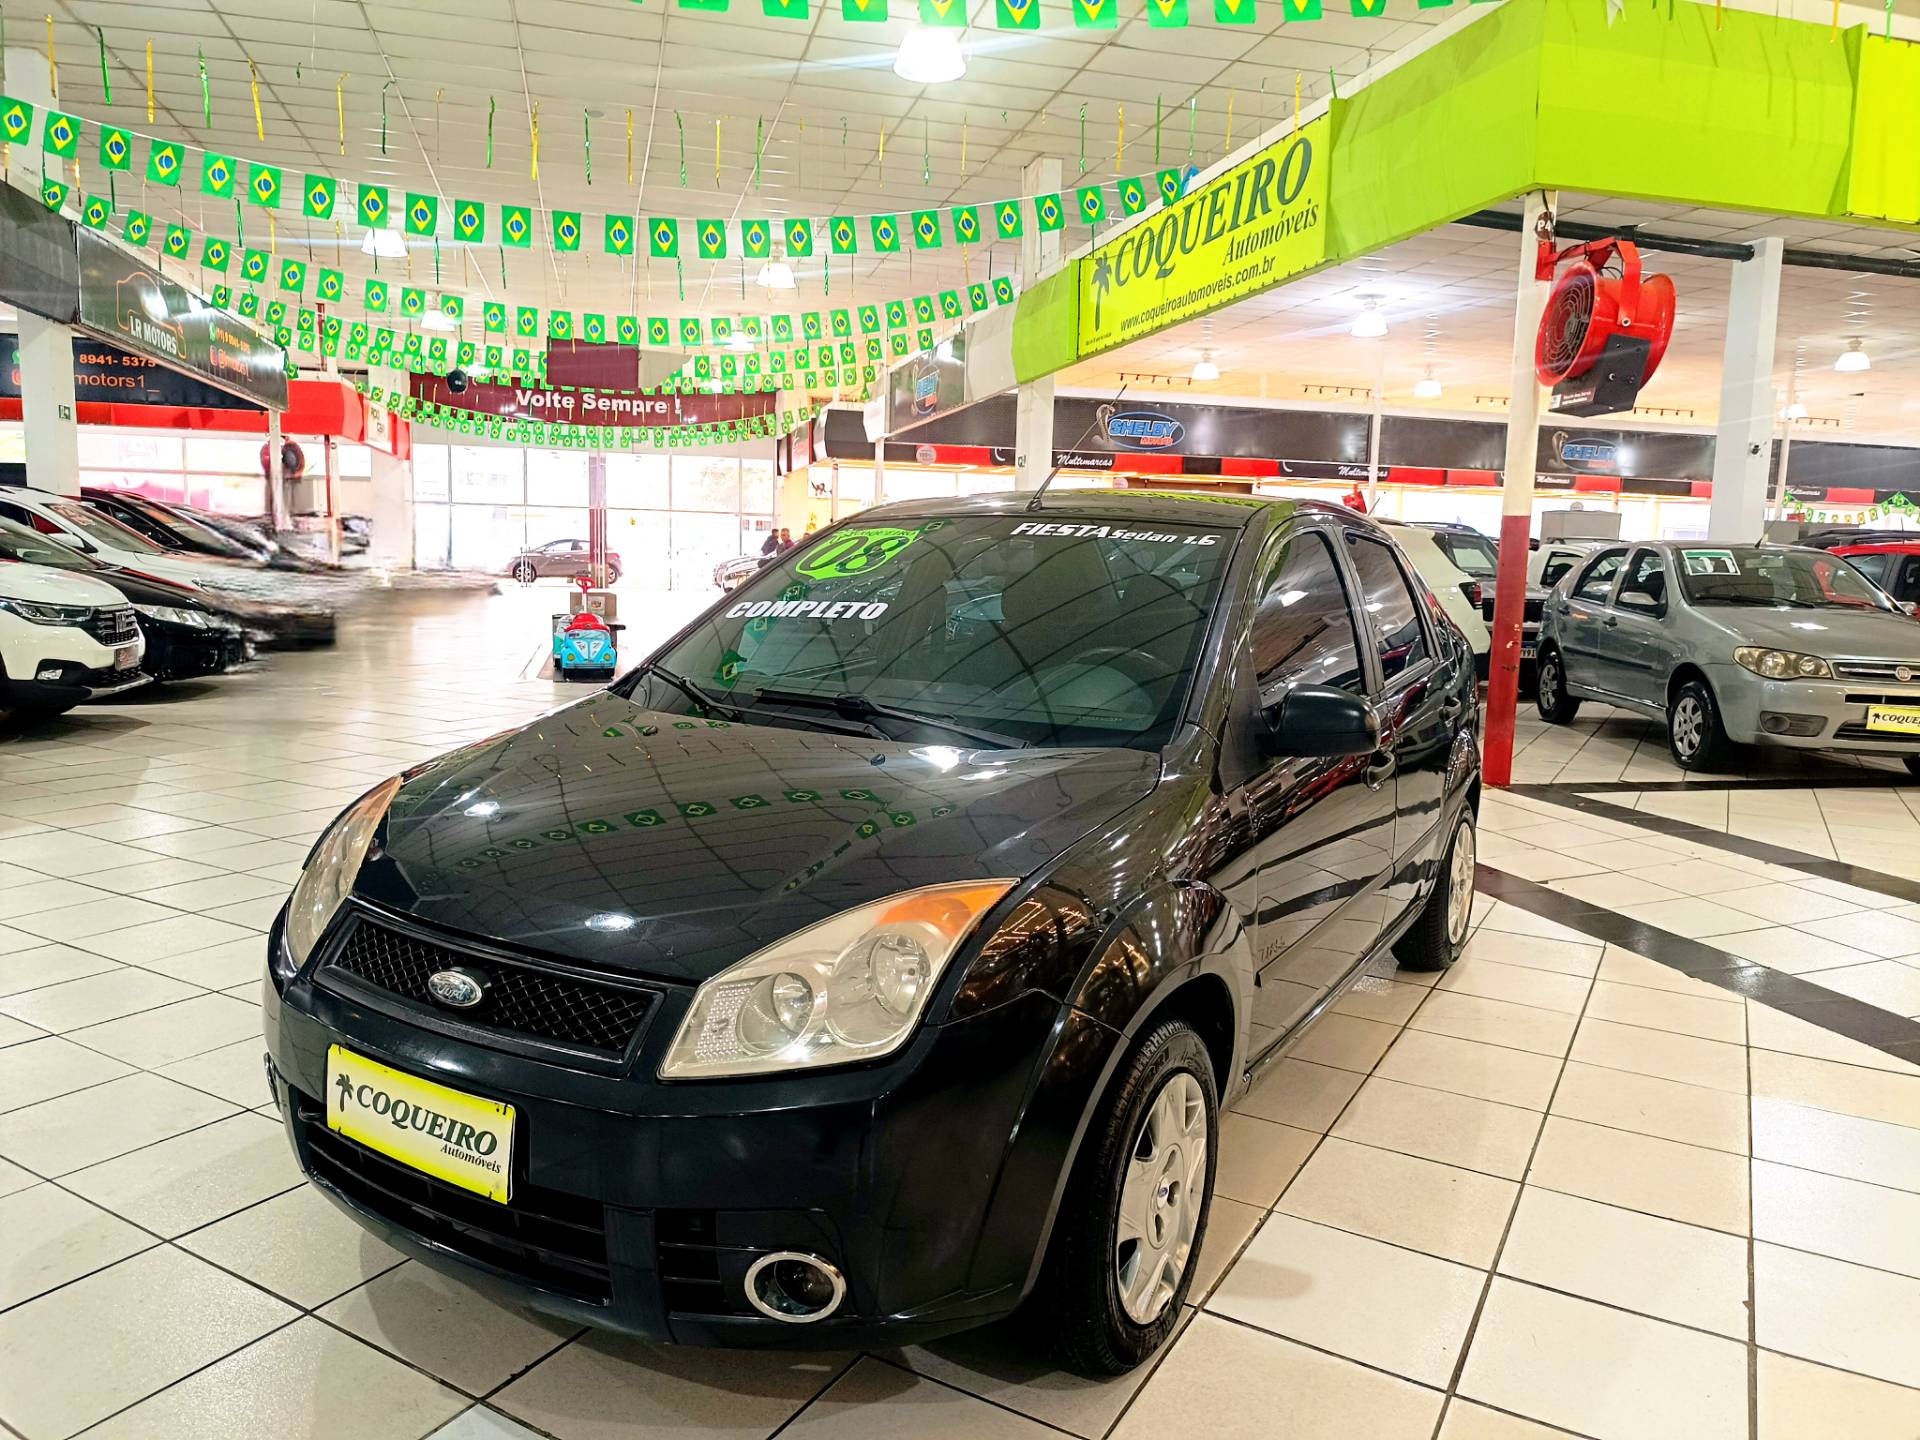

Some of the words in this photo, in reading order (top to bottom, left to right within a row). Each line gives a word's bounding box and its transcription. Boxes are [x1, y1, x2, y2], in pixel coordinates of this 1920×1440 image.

[1115, 137, 1313, 287] COQUEIRO
[1222, 198, 1319, 266] Automóveis
[1120, 254, 1277, 331] www.coqueiroautomoveis.com.br
[130, 315, 143, 339] LR
[143, 321, 177, 354] MOTORS
[79, 353, 118, 365] 8941-
[122, 356, 157, 368] 5375
[515, 389, 576, 408] Volte
[582, 393, 668, 416] Sempre
[1108, 418, 1179, 437] SHELBY
[1056, 454, 1113, 467] Multimarcas
[1010, 522, 1111, 538] FIESTA
[1107, 529, 1178, 543] Sedan
[1182, 534, 1222, 546] 1.6
[799, 535, 911, 574] 08
[725, 600, 889, 620] COMPLETO
[356, 1084, 498, 1156] COQUEIRO
[440, 1143, 501, 1174] Automóveis
